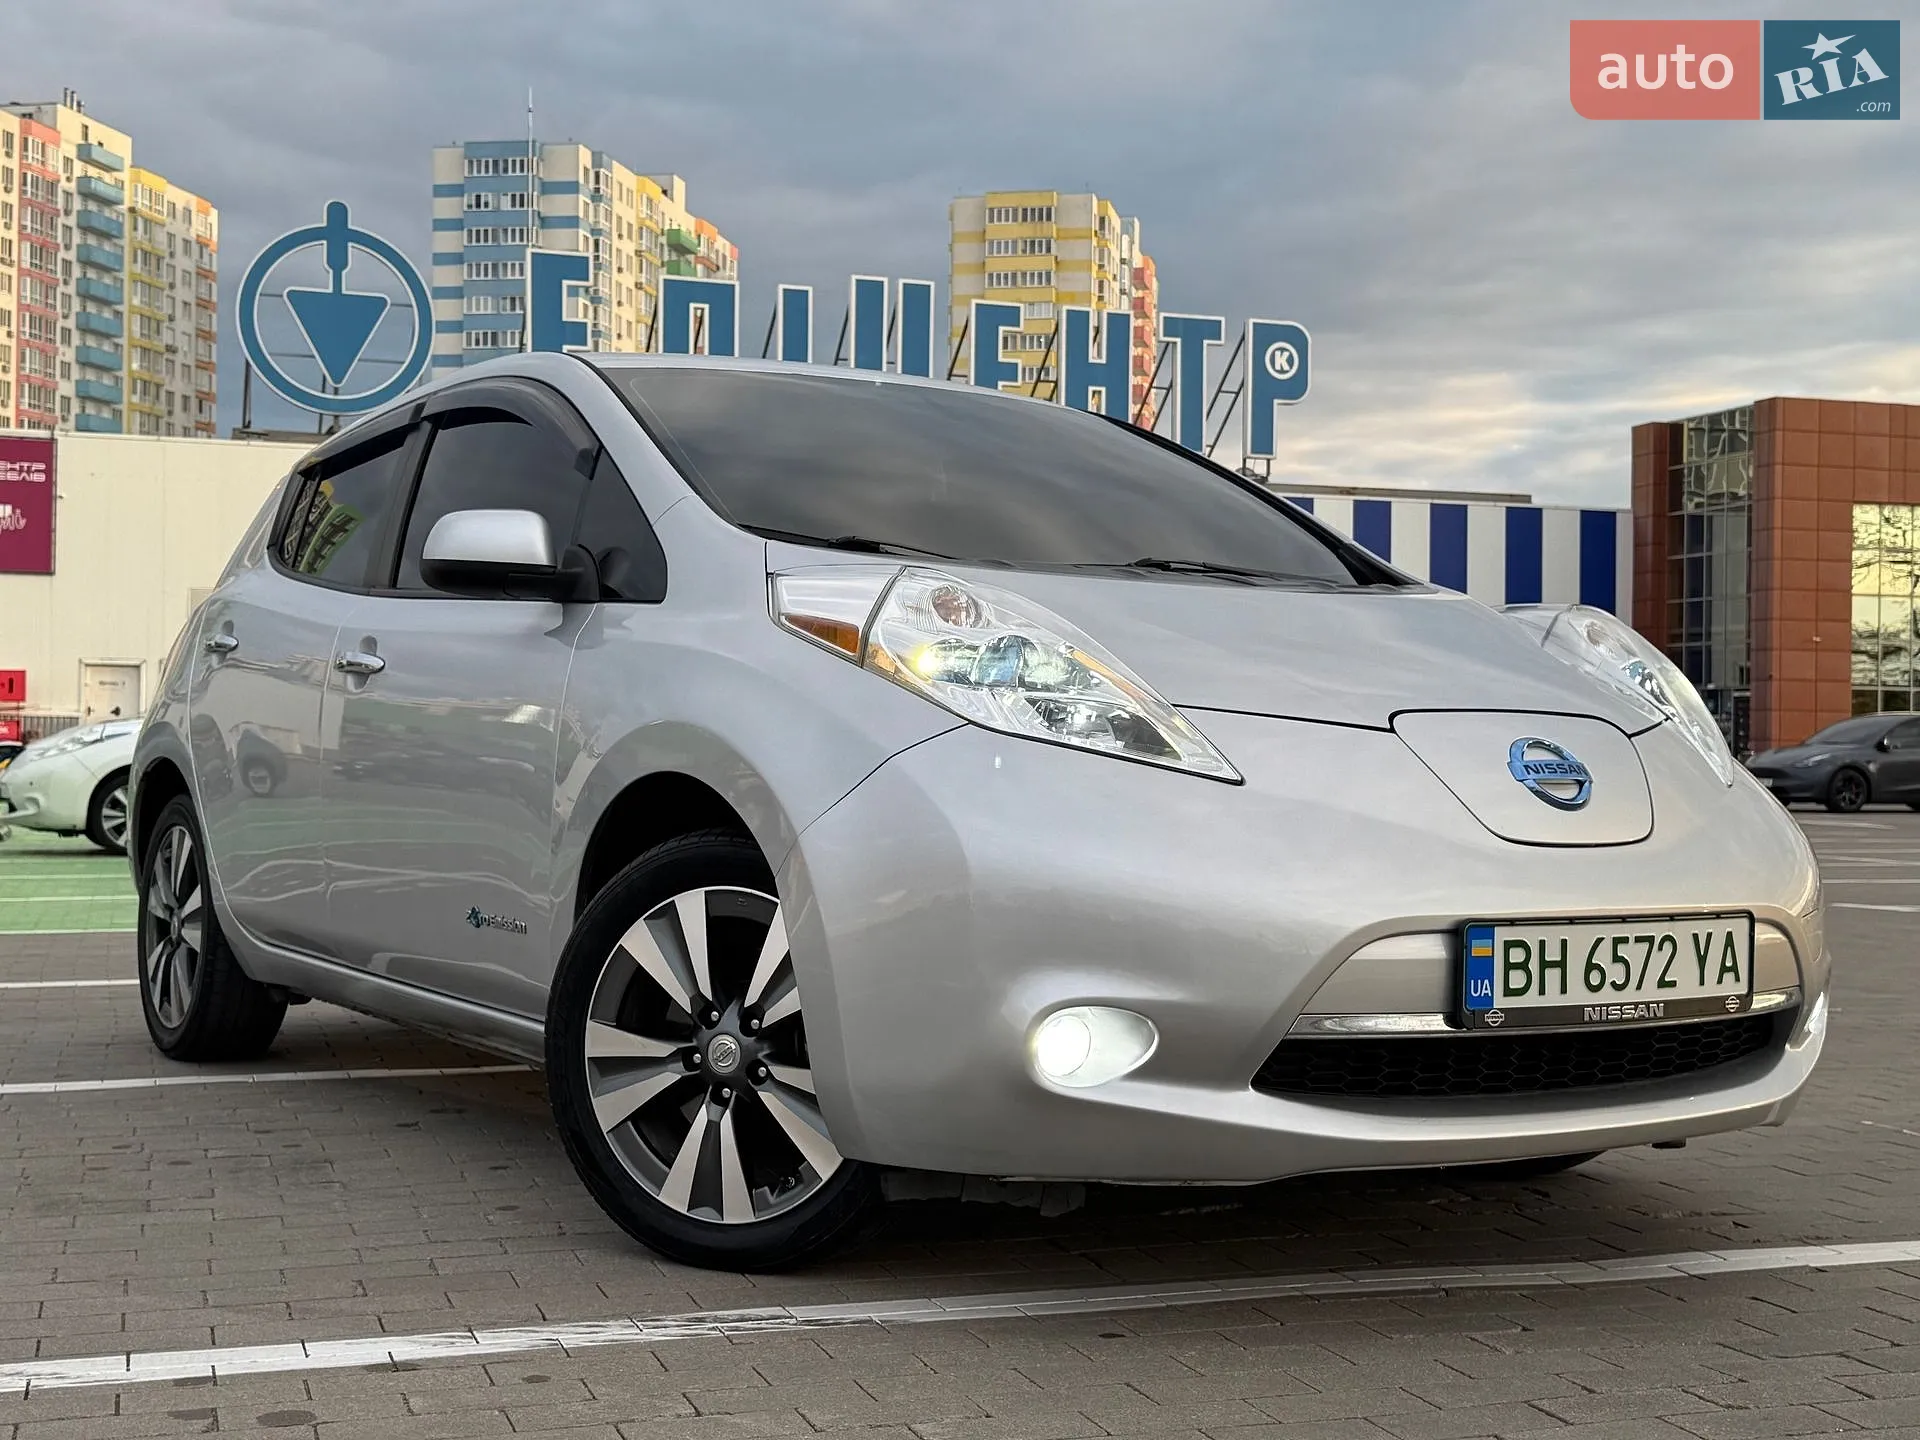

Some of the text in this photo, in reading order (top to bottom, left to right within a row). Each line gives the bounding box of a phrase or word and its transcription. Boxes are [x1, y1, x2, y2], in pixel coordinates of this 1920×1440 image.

[1523, 763, 1591, 777] NISSAN
[1503, 930, 1741, 997] BH 6572 YA
[1470, 979, 1491, 997] UA
[1583, 1003, 1665, 1022] NISSAN
